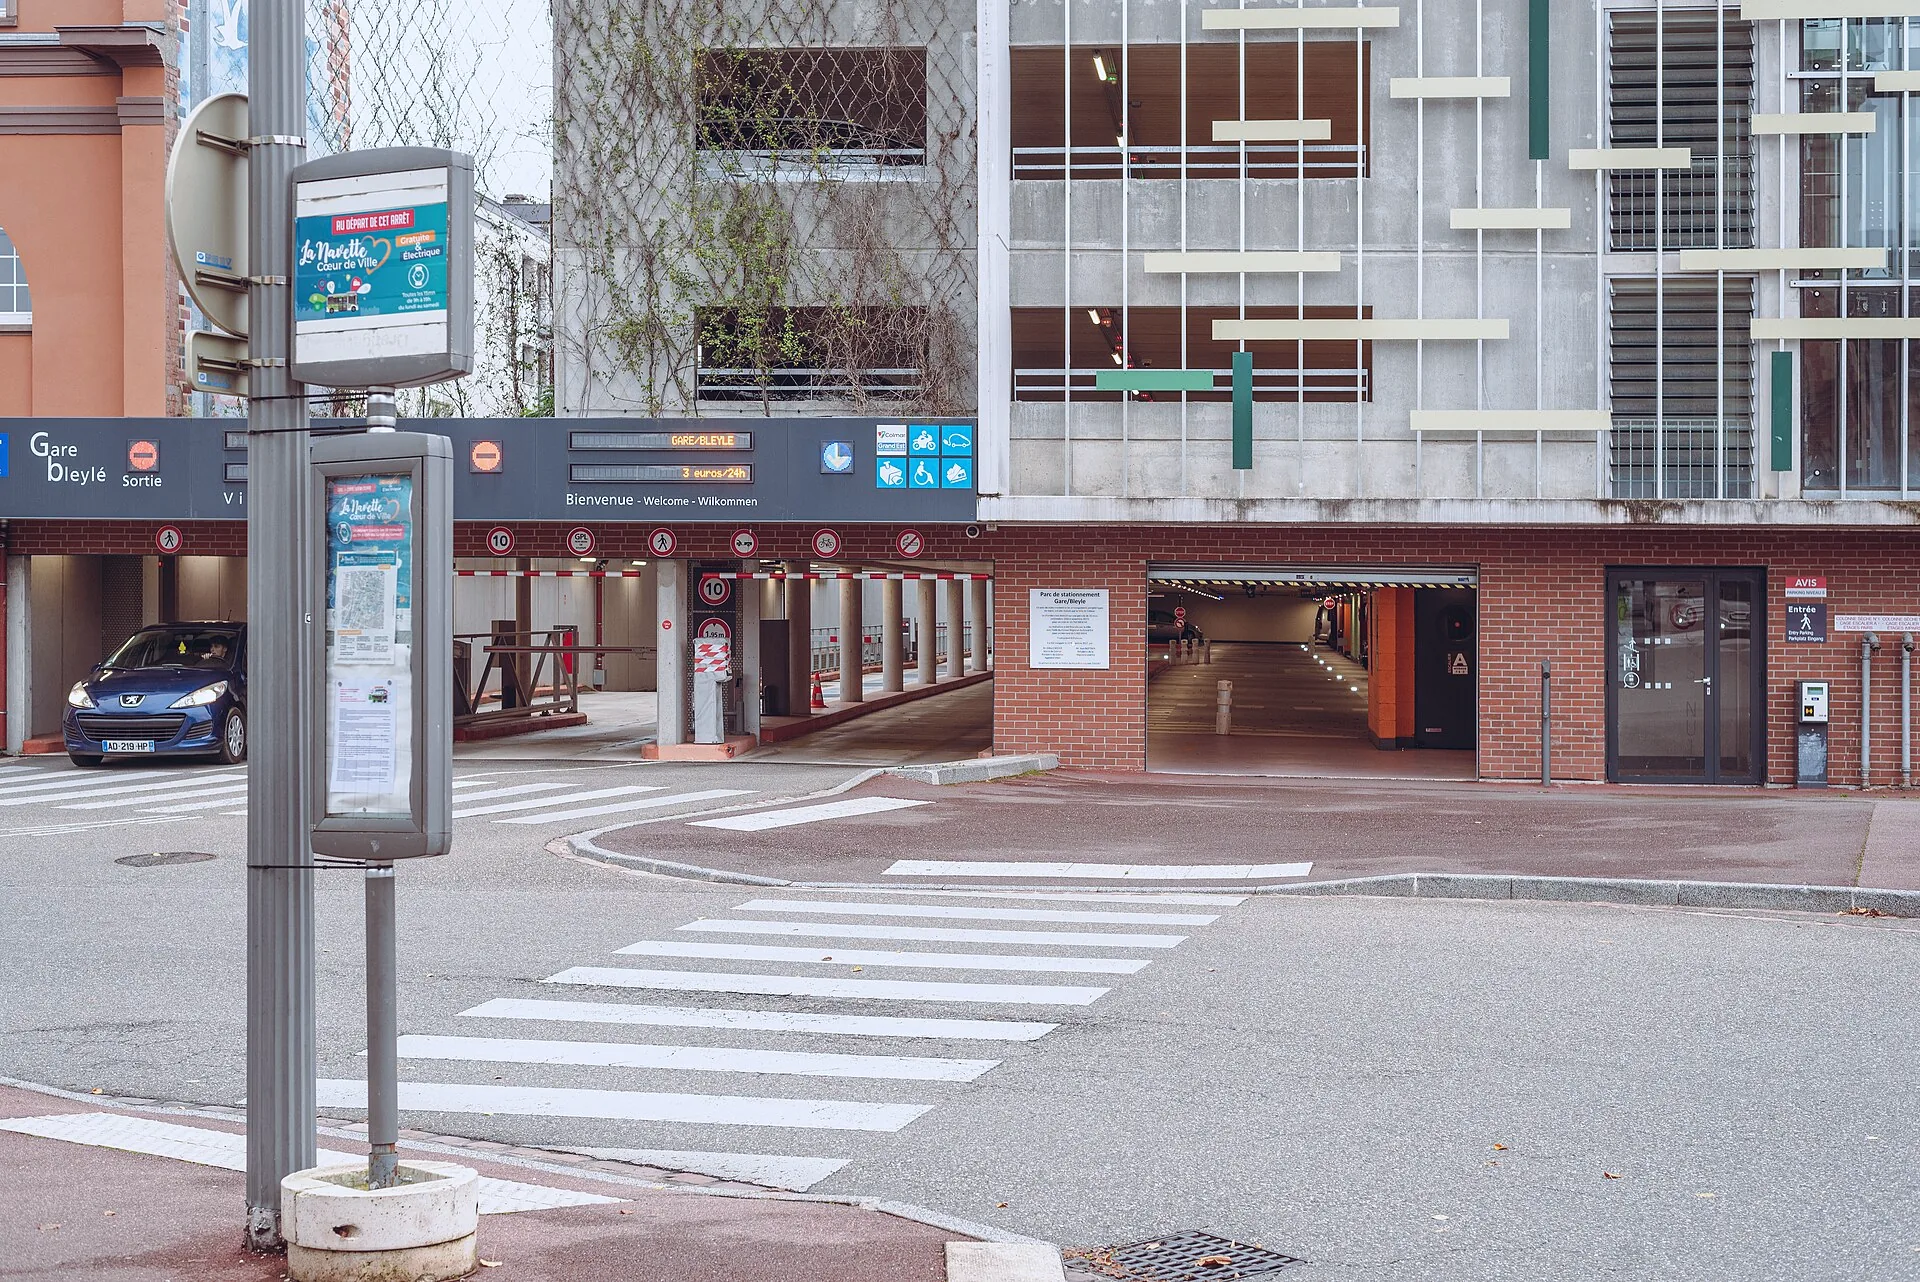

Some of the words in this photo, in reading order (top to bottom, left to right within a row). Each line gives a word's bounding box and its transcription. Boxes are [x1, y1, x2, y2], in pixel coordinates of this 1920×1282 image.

[336, 220, 344, 231] AU
[346, 216, 368, 230] DÉPART
[370, 217, 378, 228] DE
[379, 215, 390, 227] CET
[391, 212, 410, 225] ARRÊT
[400, 234, 430, 245] Gratuite
[299, 239, 316, 266] La
[316, 238, 368, 260] Navette
[403, 247, 441, 260] Électrique
[317, 261, 342, 272] Cœur
[344, 259, 356, 269] de
[358, 257, 378, 269] Ville
[30, 431, 78, 457] Gare
[671, 435, 735, 445] GARE/BLEYLE
[682, 468, 689, 478] 3
[694, 467, 746, 478] euros/24h
[122, 475, 162, 487] Sortie
[566, 493, 634, 506] Bienvenue
[643, 496, 689, 506] Welcome
[698, 496, 758, 506] Wilkommen
[351, 498, 384, 515] Navette
[493, 535, 508, 547] 10
[1795, 578, 1817, 587] AVIS
[706, 583, 723, 596] 10
[1788, 605, 1816, 613] Entrée
[1453, 653, 1468, 666] A
